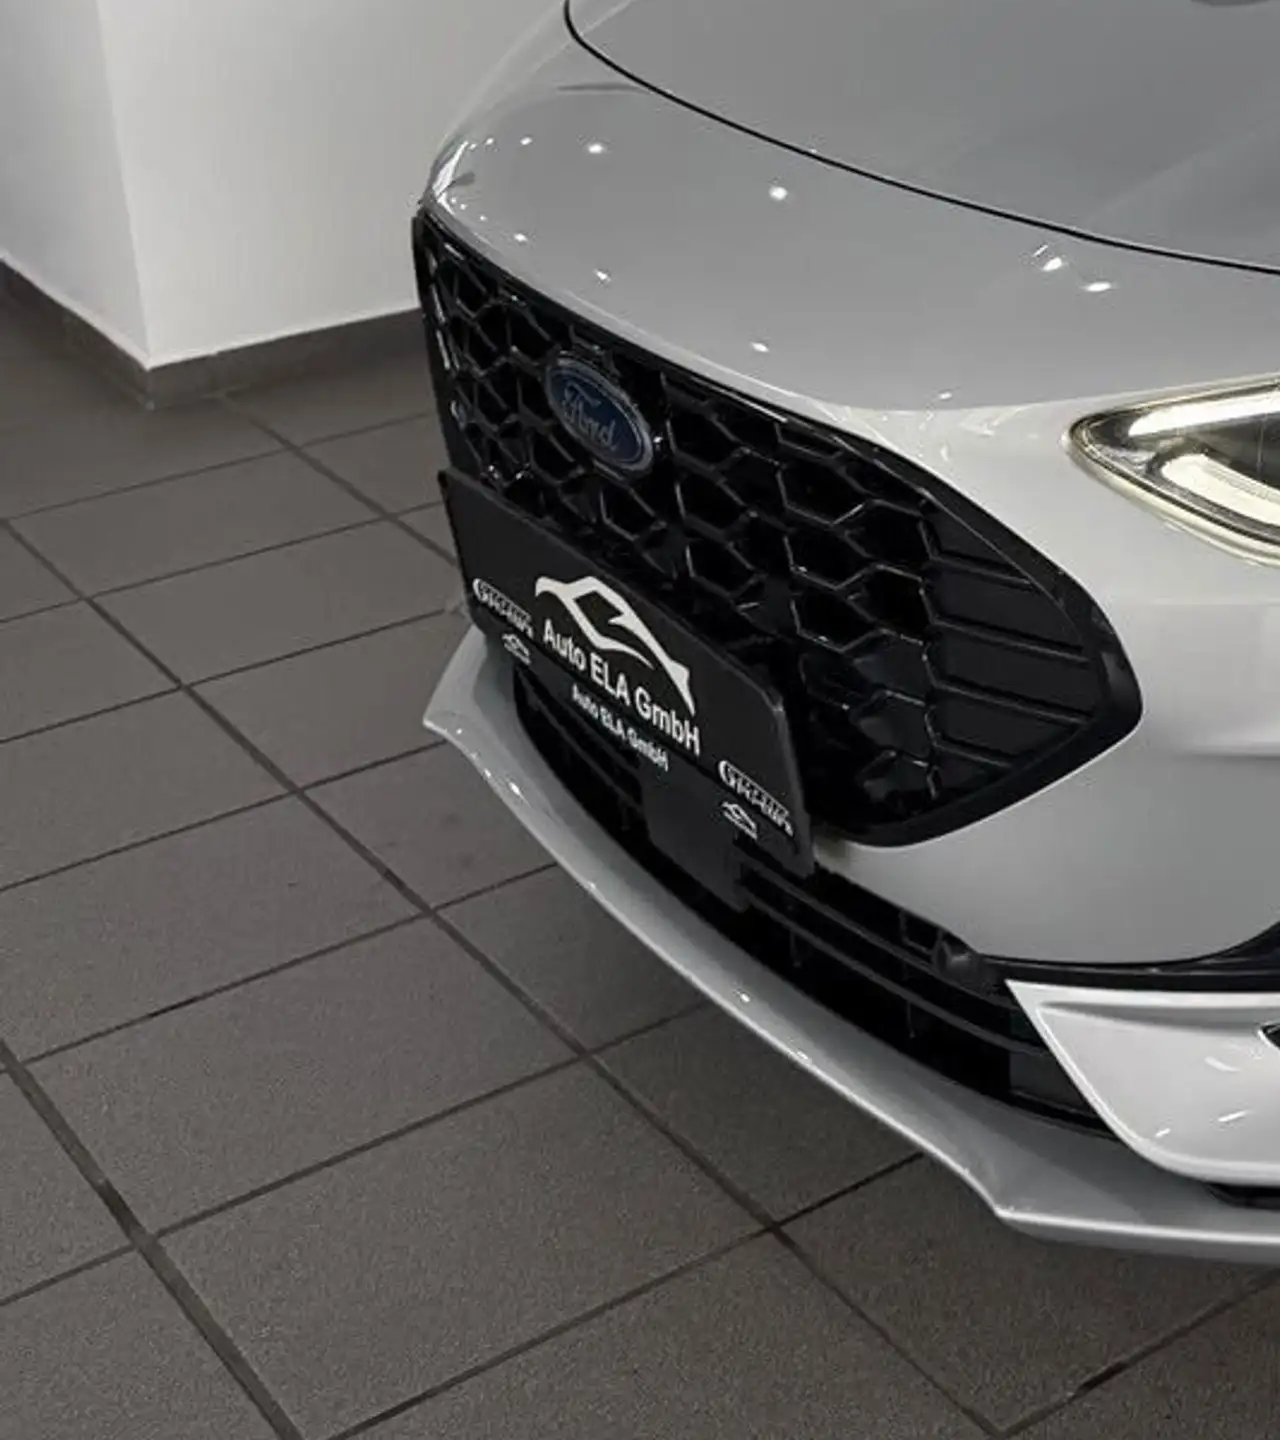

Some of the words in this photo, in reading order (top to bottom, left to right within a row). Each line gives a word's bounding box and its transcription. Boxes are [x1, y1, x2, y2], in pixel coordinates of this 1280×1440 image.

[561, 380, 618, 452] Ford
[543, 618, 587, 671] Auto
[590, 651, 631, 707] ELA
[634, 686, 700, 757] GmbH
